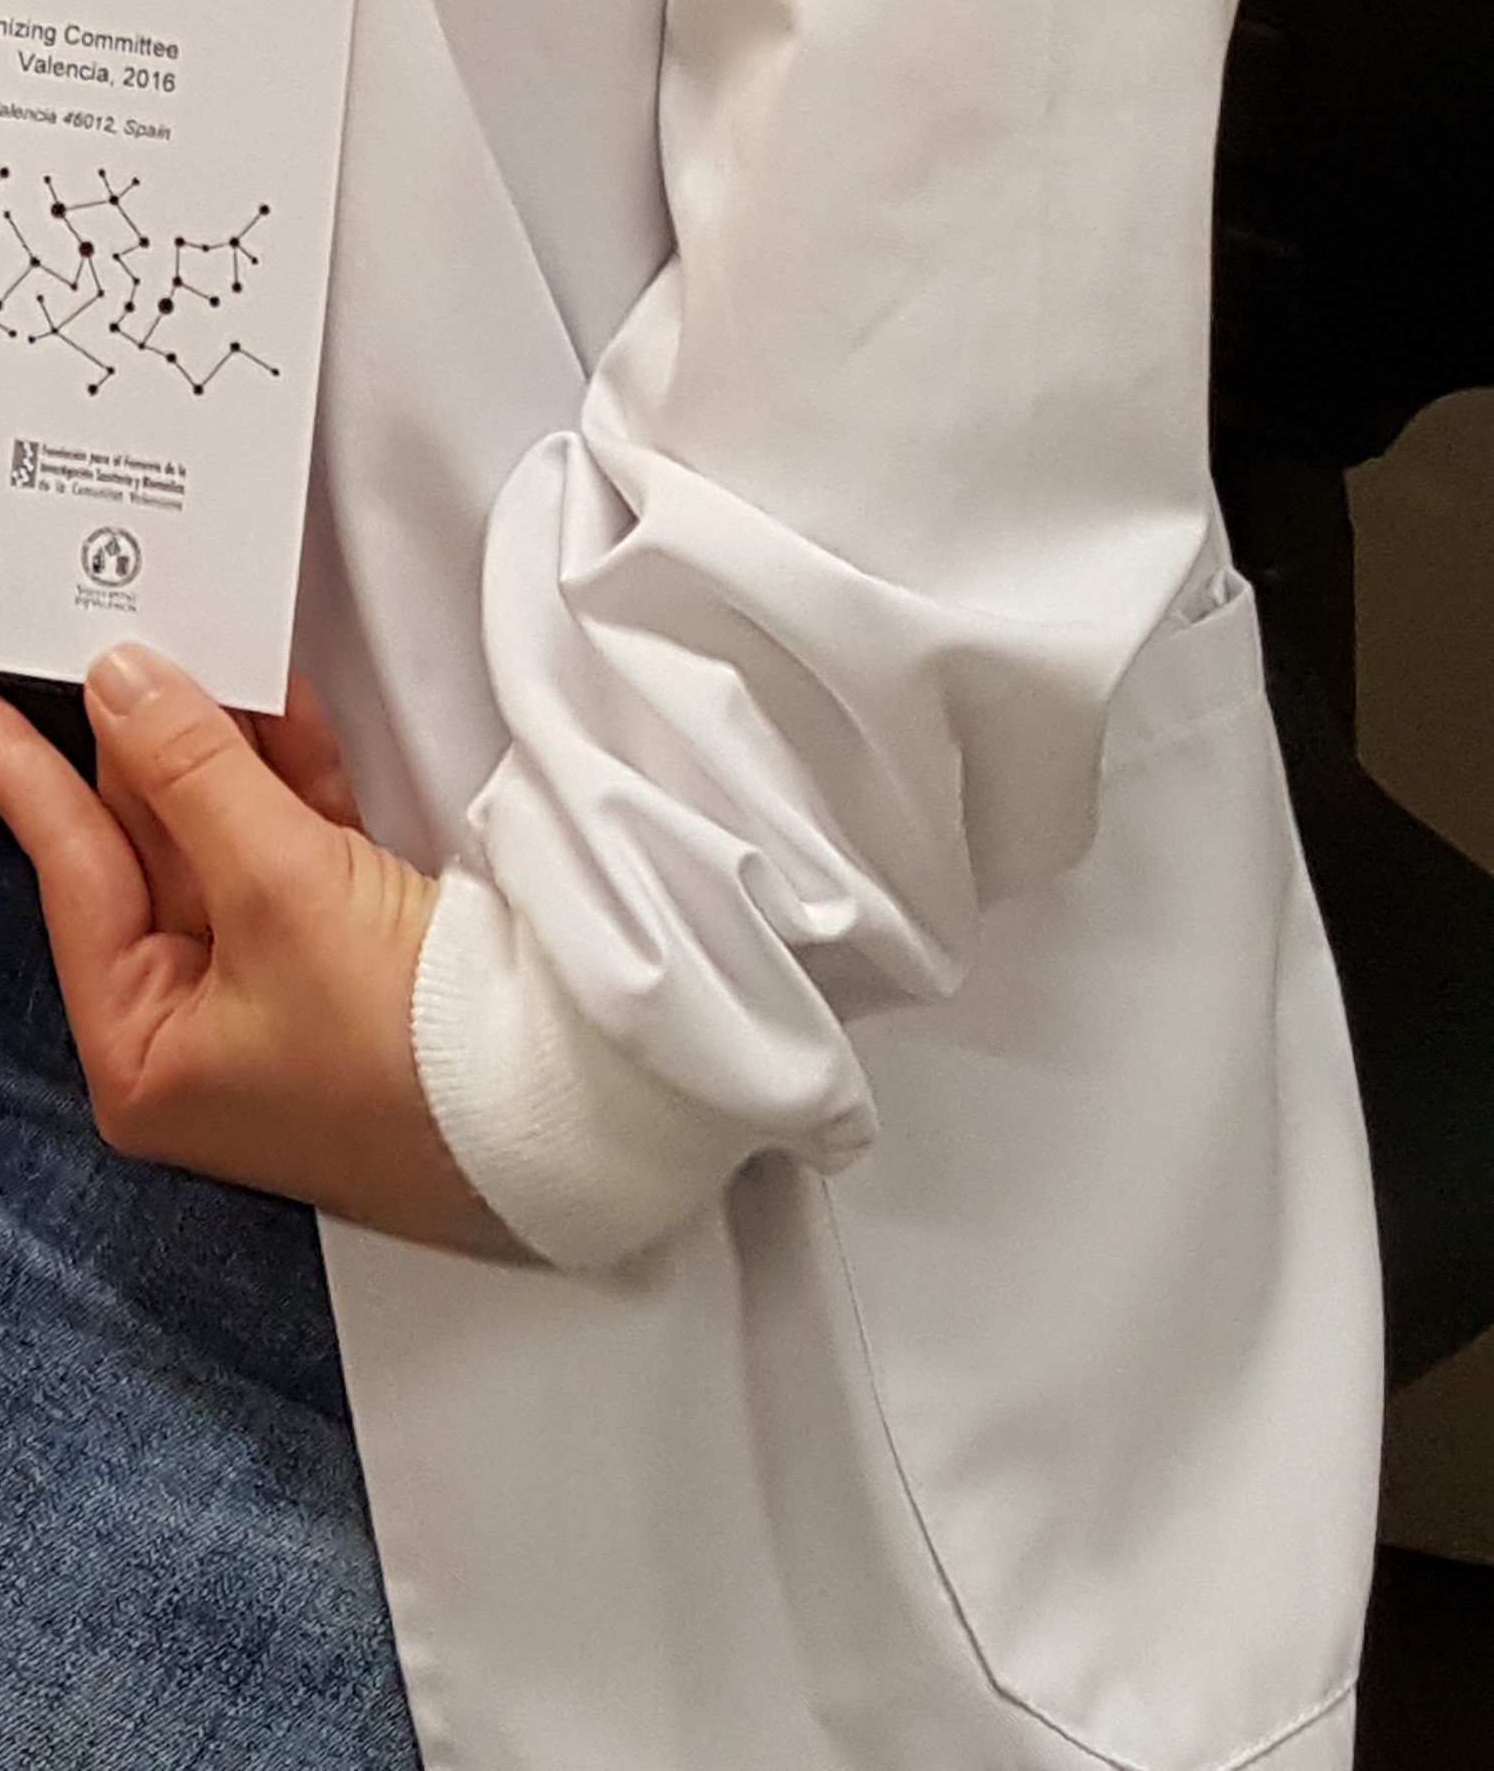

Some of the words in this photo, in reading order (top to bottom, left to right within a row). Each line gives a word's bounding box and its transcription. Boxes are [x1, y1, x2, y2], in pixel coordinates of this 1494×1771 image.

[63, 24, 179, 60] Committee
[17, 49, 114, 87] Valencia,
[122, 65, 175, 93] 2016
